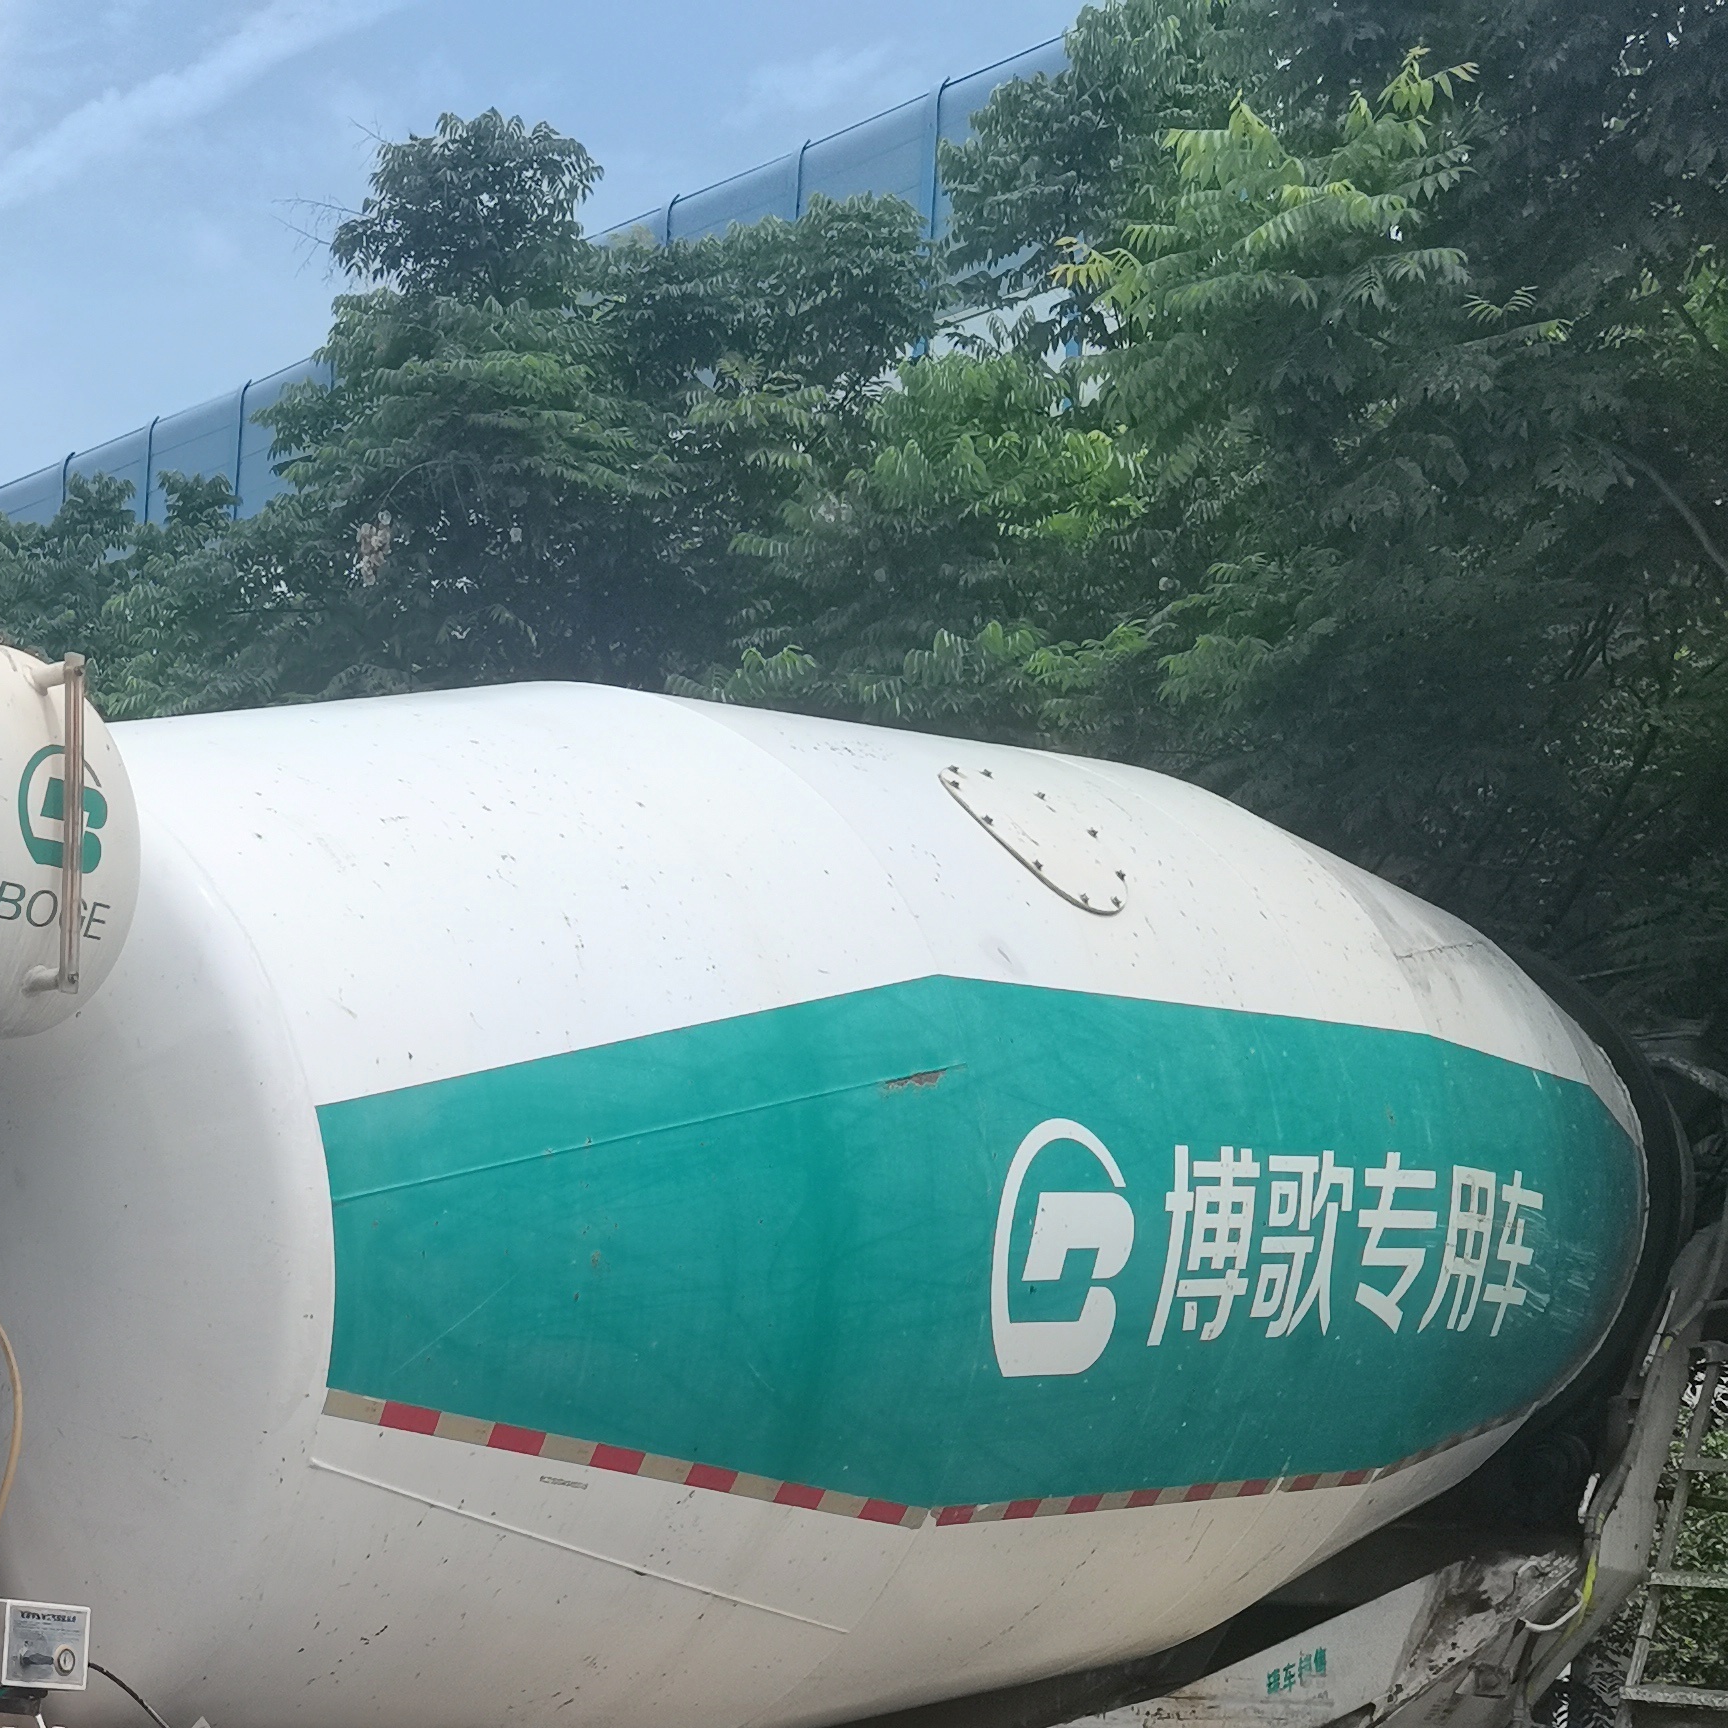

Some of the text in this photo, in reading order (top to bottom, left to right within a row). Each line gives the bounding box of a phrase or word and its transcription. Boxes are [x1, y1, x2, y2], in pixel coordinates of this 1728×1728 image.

[1147, 1145, 1543, 1346] 博歌专用车
